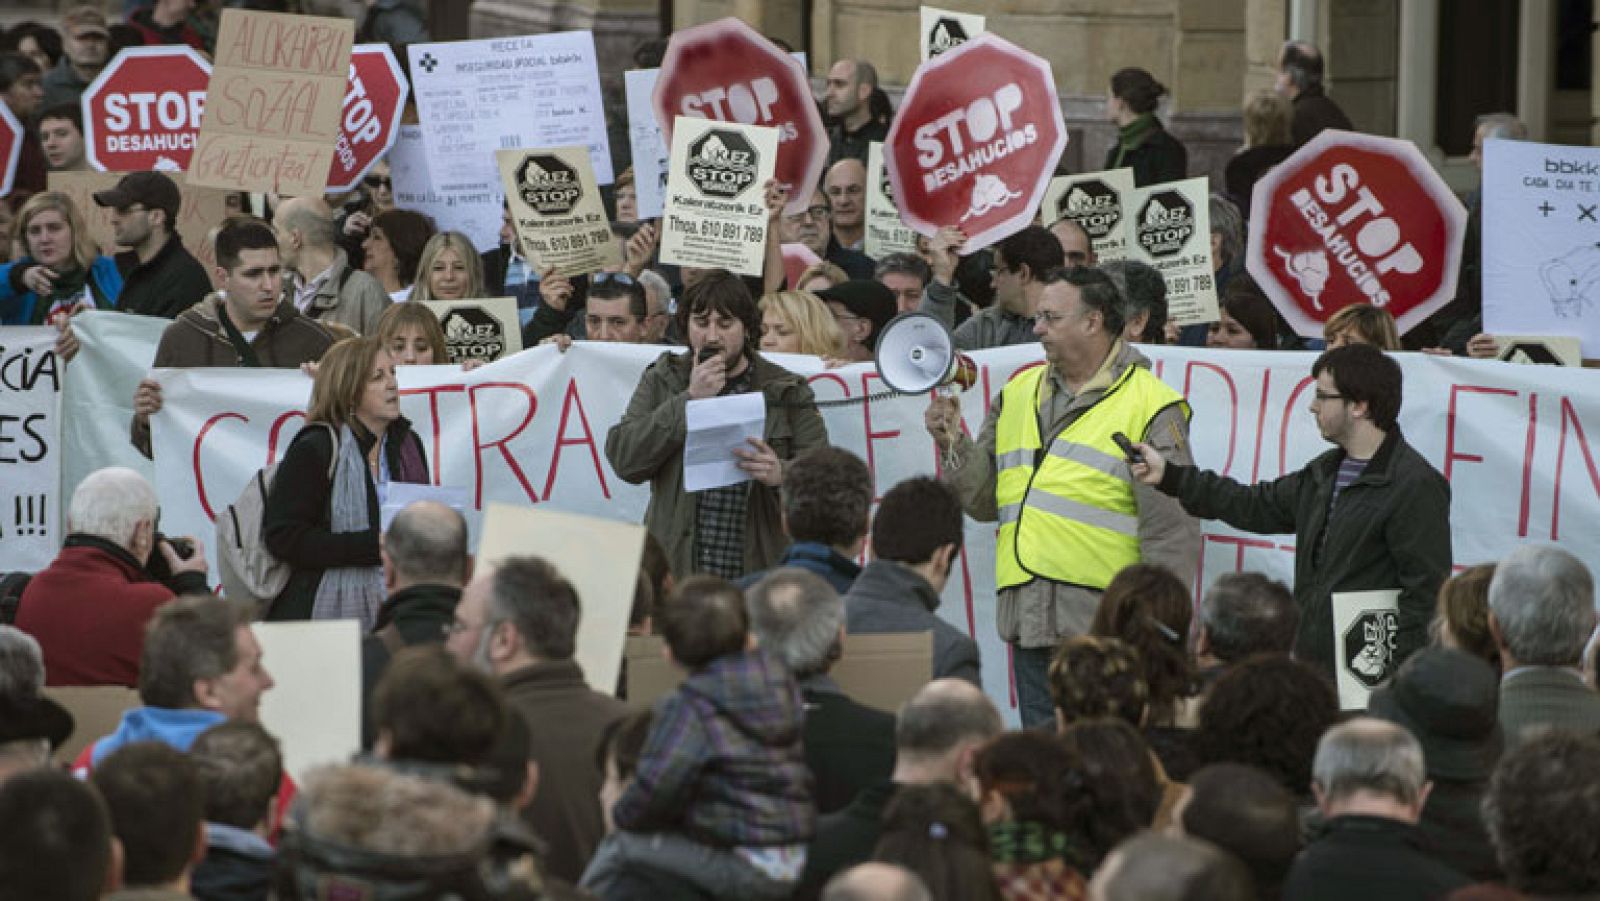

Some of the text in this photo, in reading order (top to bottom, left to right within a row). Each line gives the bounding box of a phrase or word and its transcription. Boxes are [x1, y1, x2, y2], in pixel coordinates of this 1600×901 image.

[343, 64, 381, 144] TOP
[915, 83, 1022, 168] STOP
[106, 133, 198, 152] DESAHUCI
[924, 123, 1037, 193] DESAHUCIOS
[692, 167, 753, 185] STOP
[525, 188, 578, 204] STOP
[1078, 214, 1119, 228] TOP
[1314, 163, 1424, 275] STOP
[550, 235, 569, 251] 610
[570, 232, 588, 249] 891
[589, 229, 609, 244] 789
[701, 220, 721, 237] 610
[722, 222, 741, 240] 891
[743, 224, 764, 243] 789
[1140, 226, 1192, 245] STOP
[1289, 188, 1391, 307] DESAHUCIOS
[193, 377, 611, 522] CTRA
